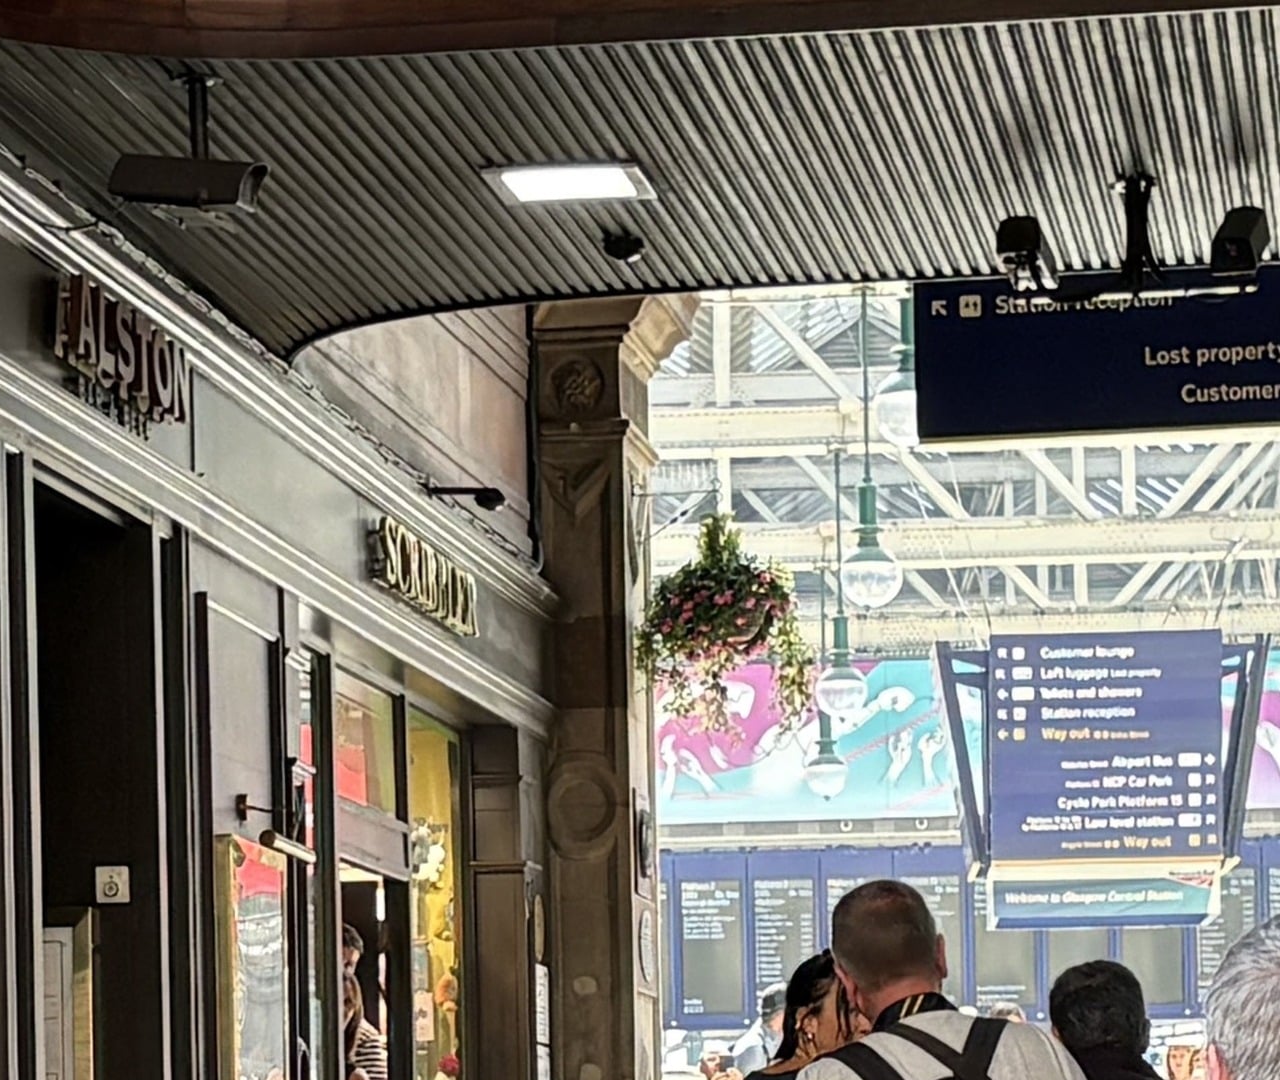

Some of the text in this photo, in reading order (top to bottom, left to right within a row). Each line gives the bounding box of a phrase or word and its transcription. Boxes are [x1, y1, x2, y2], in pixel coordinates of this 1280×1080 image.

[70, 272, 192, 425] ALSTON
[1144, 346, 1191, 366] Lost
[1040, 645, 1135, 659] Customer lounge
[1041, 727, 1091, 742] Way out
